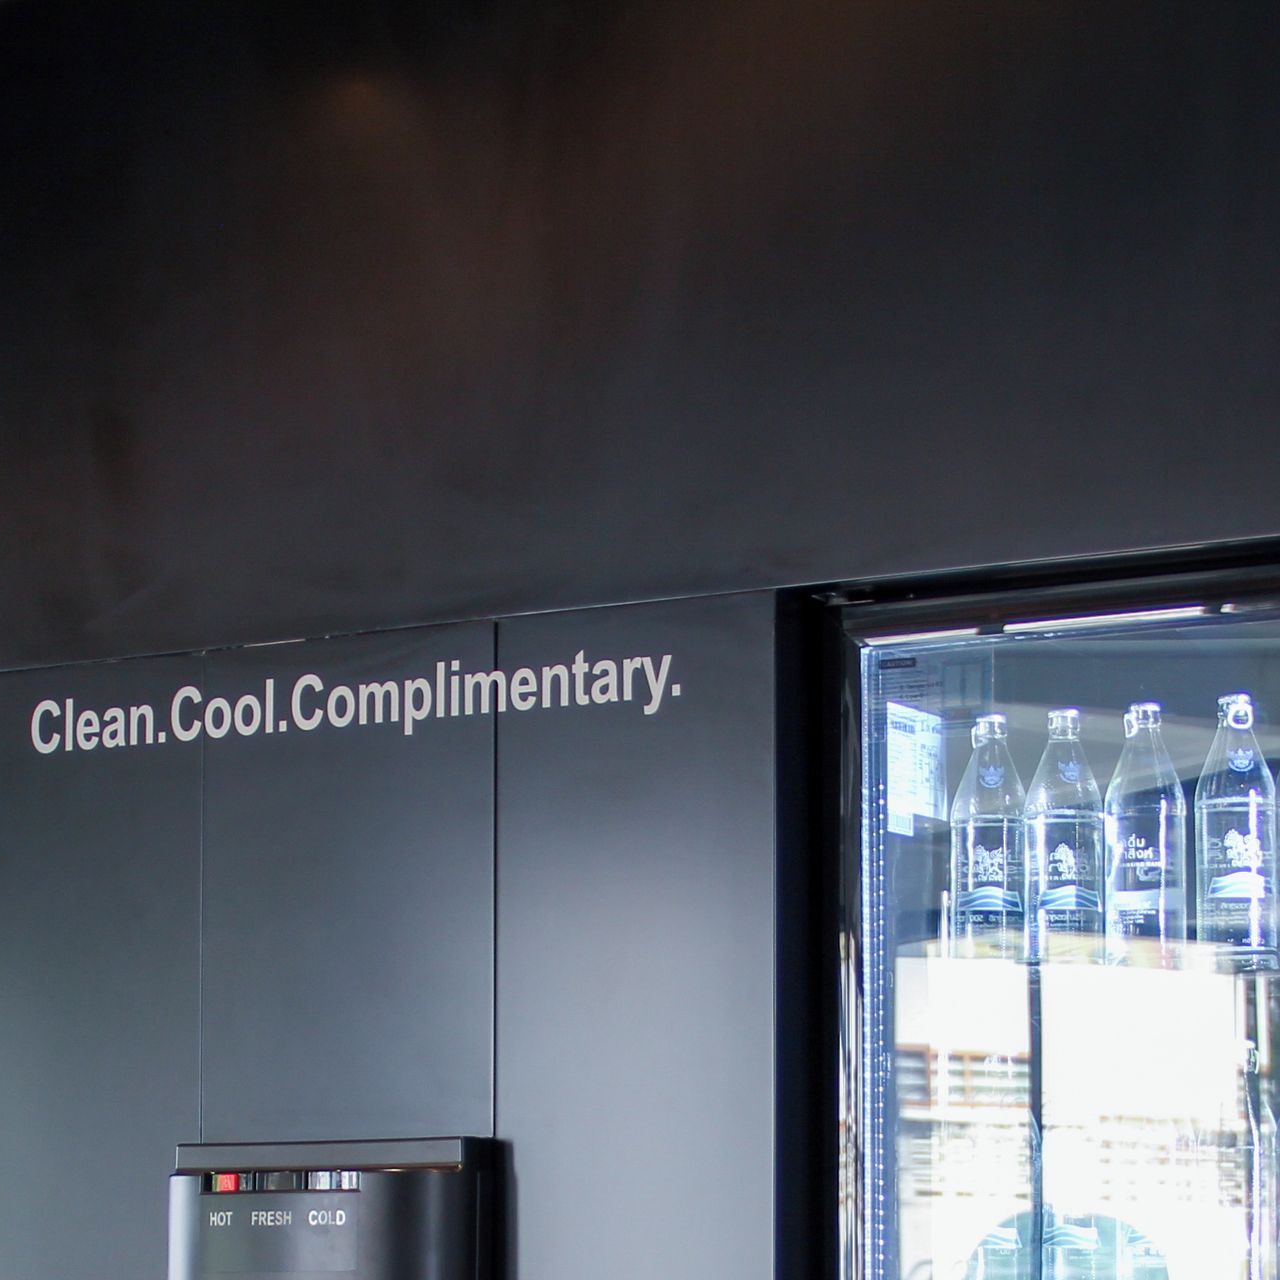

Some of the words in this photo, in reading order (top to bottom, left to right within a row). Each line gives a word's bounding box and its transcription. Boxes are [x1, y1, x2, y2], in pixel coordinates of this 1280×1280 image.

[209, 1211, 233, 1226] HOT
[251, 1210, 292, 1226] FRESH
[308, 1209, 346, 1226] COLD
